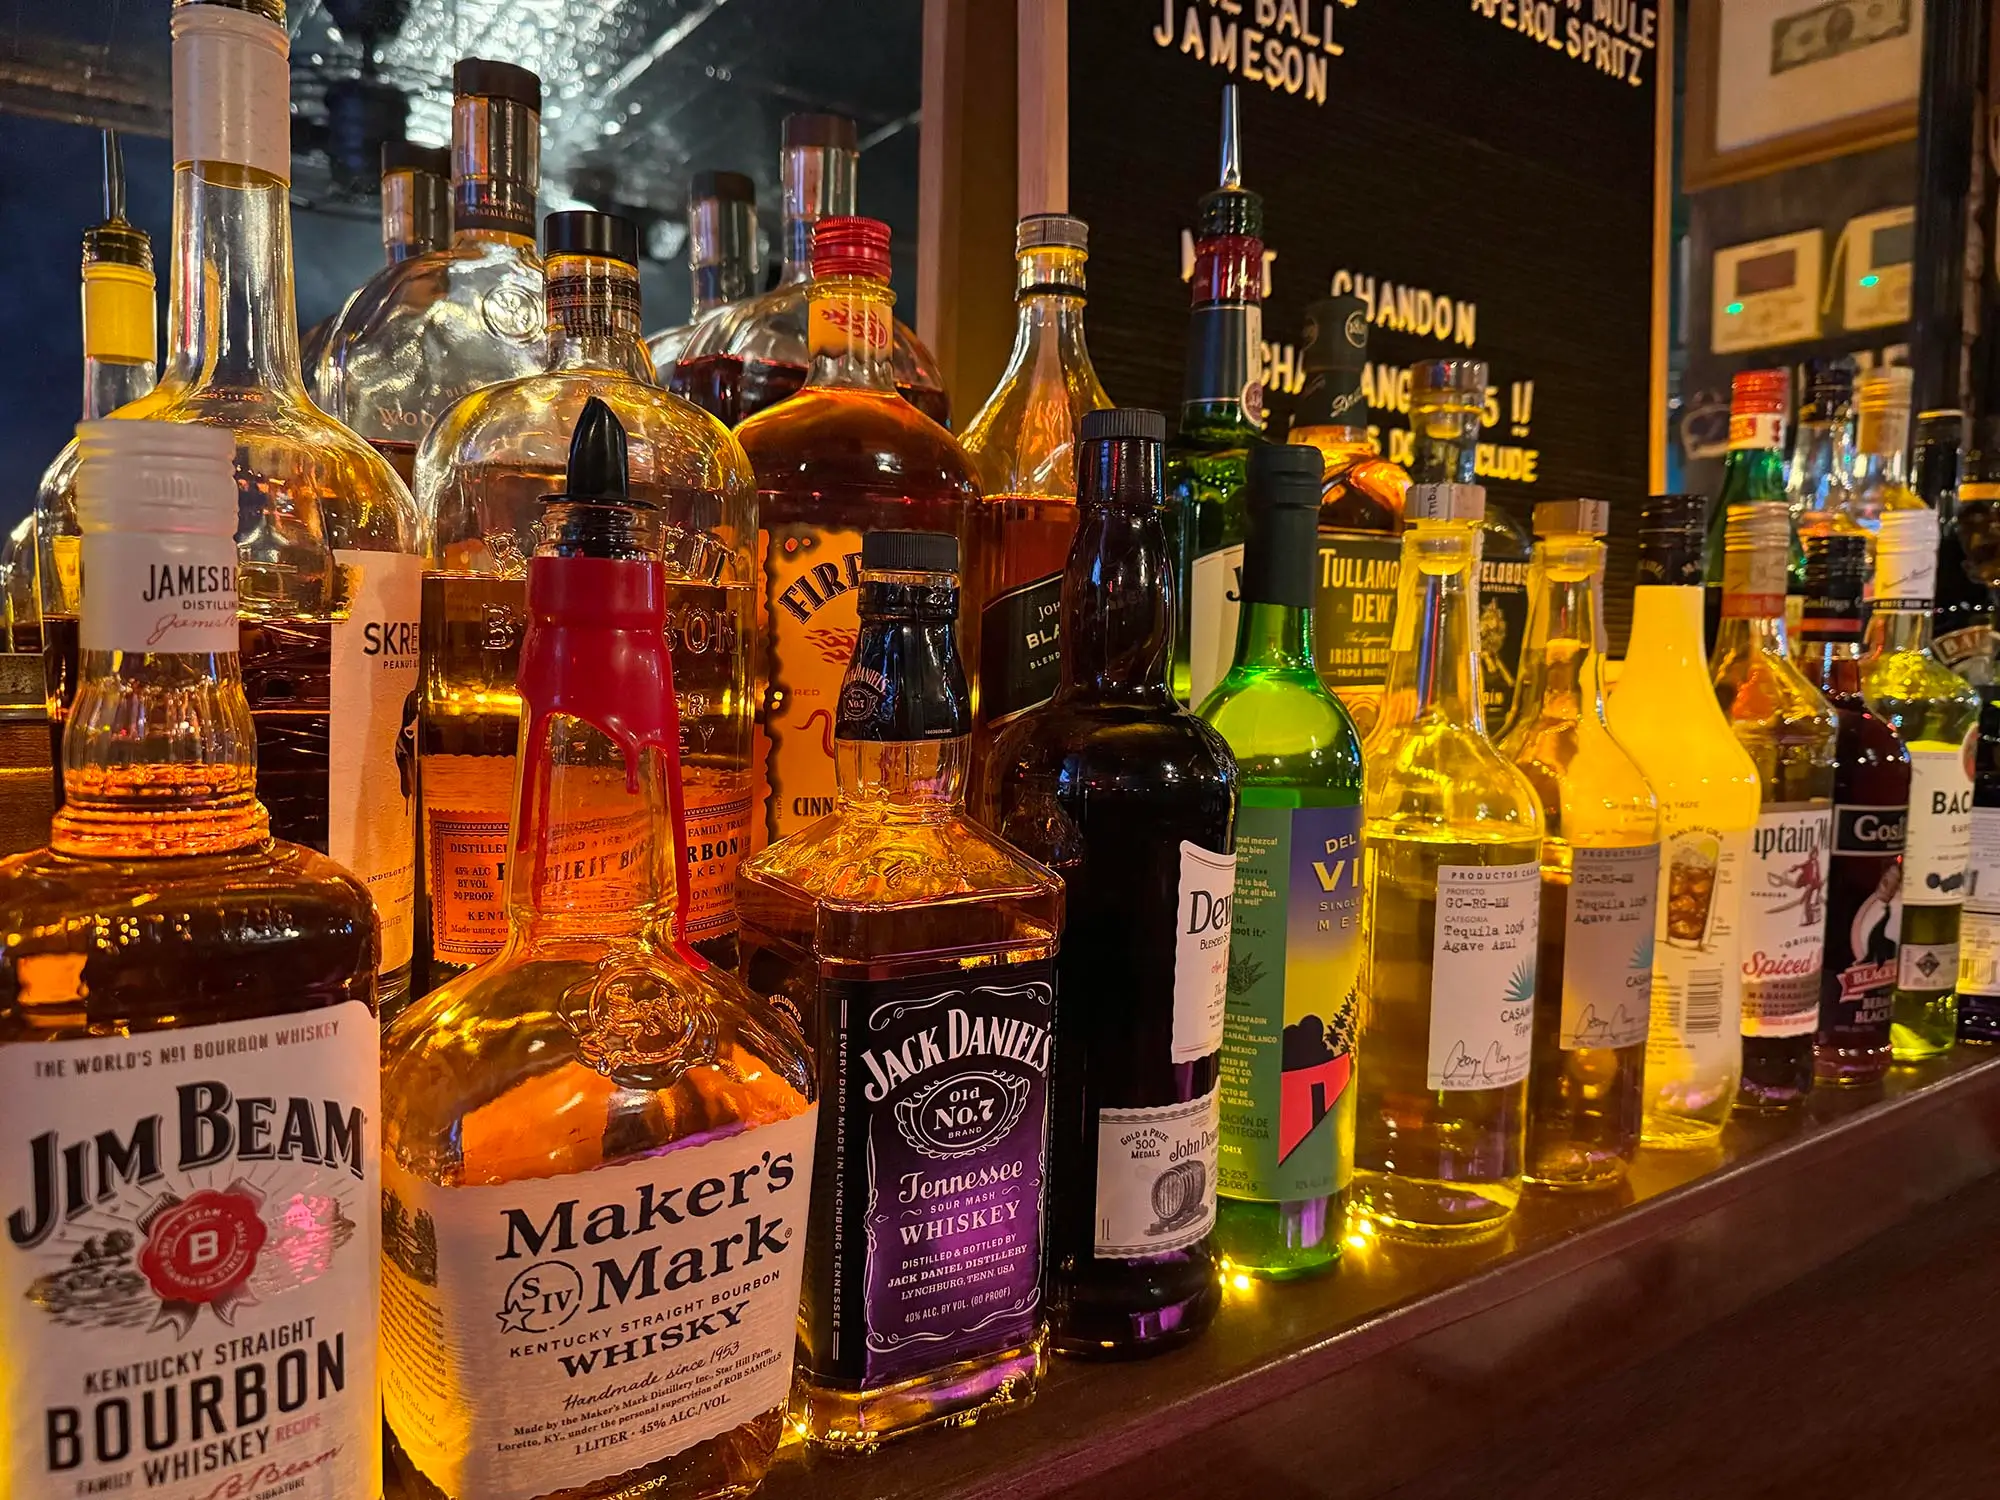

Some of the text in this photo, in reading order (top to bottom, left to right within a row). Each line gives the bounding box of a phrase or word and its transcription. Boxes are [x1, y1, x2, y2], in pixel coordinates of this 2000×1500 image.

[1255, 0, 1343, 56] BALL
[1154, 0, 1328, 106] JAMESON
[1470, 0, 1643, 88] EROL SPRITZ
[1474, 443, 1540, 482] CLUDE
[143, 564, 218, 602] JAMES
[1318, 549, 1398, 589] TULLAMO
[1038, 601, 1061, 622] JOH
[1352, 592, 1392, 623] DEW
[1026, 623, 1061, 649] BLA
[1029, 651, 1061, 670] BLEND
[1330, 648, 1359, 664] IRISH
[794, 688, 820, 697] RED
[793, 796, 836, 818] CINN
[1932, 791, 1970, 814] BAC
[687, 823, 723, 838] FAMILY
[1251, 836, 1278, 846] mezcal
[1325, 834, 1356, 854] DEL
[450, 842, 507, 854] DISTILLE
[688, 836, 738, 863] RBON
[1312, 857, 1360, 892] VI
[1451, 870, 1518, 880] PRODUCTOS
[464, 891, 493, 901] PROOF
[1261, 889, 1277, 897] that
[1446, 887, 1485, 896] PROYECTO
[468, 911, 505, 921] KENT
[1574, 914, 1613, 925] Agave
[472, 926, 496, 936] using
[1442, 938, 1517, 953] Agave Azul
[1443, 924, 1500, 938] Tequila
[1742, 950, 1813, 978] Spiced
[768, 993, 802, 1023] MELLOWED
[34, 1021, 340, 1078] THE WORLD'S BOURBON WHISKEY
[860, 1008, 1053, 1103] JACK DANIEL'S
[949, 1086, 981, 1103] Old
[947, 1125, 983, 1140] BRAND
[1120, 1131, 1141, 1146] GOLD
[1150, 1128, 1169, 1143] PRIZE
[1256, 1118, 1268, 1128] DE
[1131, 1149, 1161, 1159] MEDALS
[1135, 1139, 1156, 1150] 500
[1169, 1137, 1200, 1162] John
[7, 1079, 365, 1249] JIM BEAM
[832, 1032, 848, 1329] EVERY DROP MADE IN LYNCHBURG TENNESSEE
[897, 1159, 1025, 1204] Tennessee
[495, 1150, 796, 1262] Maker's
[929, 1190, 997, 1215] SOUR MASH
[899, 1199, 1022, 1247] WHISKEY
[587, 1214, 787, 1314] Mark
[901, 1232, 1018, 1270] DISTILLED & BOTTLED BY
[887, 1243, 1029, 1289] JACK DANIEL DISTILLERY
[900, 1277, 967, 1302] LYNCHBURG,
[996, 1263, 1016, 1276] USA
[509, 1268, 782, 1358] KENTUCKY STRAIGHT BOURBON
[903, 1309, 922, 1325] 40%
[921, 1305, 941, 1320] ALC.
[940, 1303, 951, 1316] BY
[952, 1298, 970, 1312] VOL.
[984, 1286, 1012, 1304] PROOF)
[557, 1300, 751, 1379] WHISKY
[83, 1316, 316, 1395] KENTUCKY STRAIGHT
[561, 1340, 742, 1412] Handmade since 1953
[46, 1331, 346, 1472] BOURBON
[497, 1350, 783, 1453] Loretto, under the personal supervision of ROB SAMUELS
[513, 1424, 544, 1437] Made
[545, 1419, 560, 1431] by
[561, 1414, 579, 1427] the
[579, 1403, 620, 1423] Maker's
[621, 1395, 649, 1411] Mark
[650, 1380, 694, 1401] Distillery
[714, 1365, 733, 1378] Star
[734, 1356, 751, 1370] Hill
[751, 1346, 774, 1363] Farm,
[584, 1429, 628, 1454] LITER
[638, 1416, 667, 1436] 45%
[143, 1426, 271, 1489] WHISKEY
[276, 1413, 322, 1443] RECIPE
